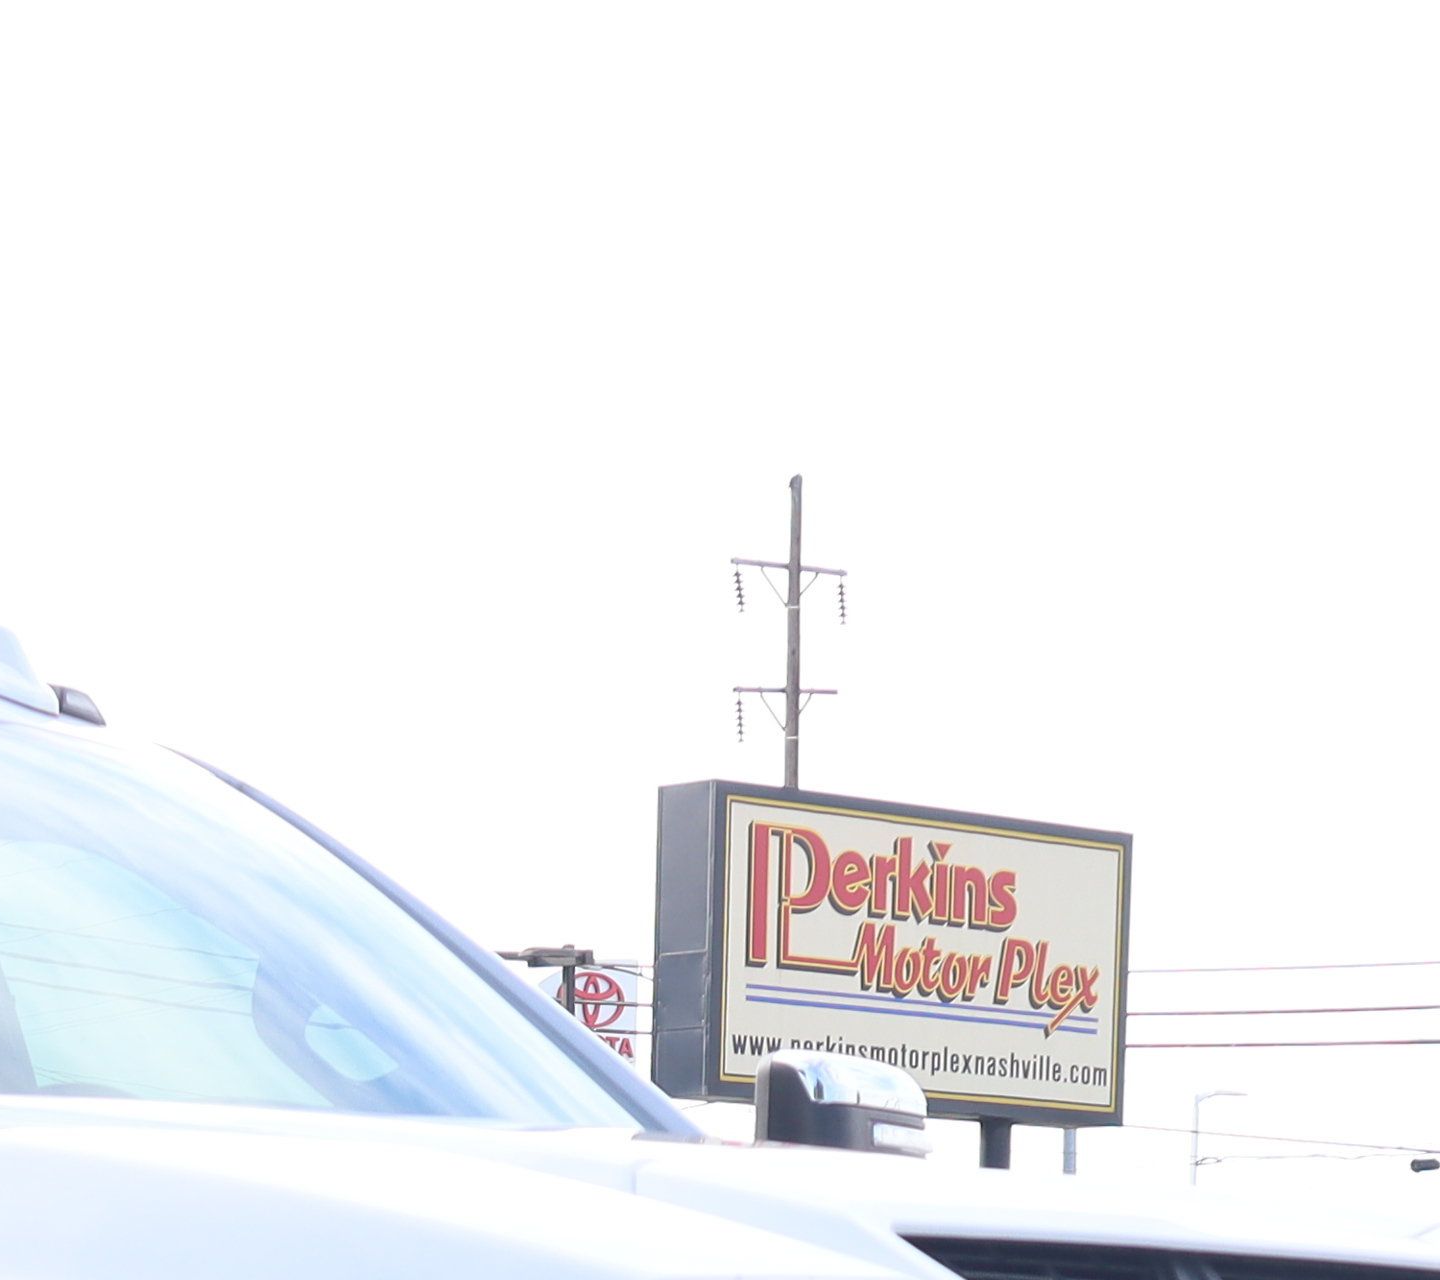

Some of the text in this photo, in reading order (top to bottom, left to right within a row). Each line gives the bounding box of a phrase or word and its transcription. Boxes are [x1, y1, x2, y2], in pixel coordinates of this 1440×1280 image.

[745, 820, 1017, 967] Perkins
[852, 921, 1101, 1039] Motor Plex
[732, 1034, 1108, 1087] wwwerkinsmotorplexnashville.com
